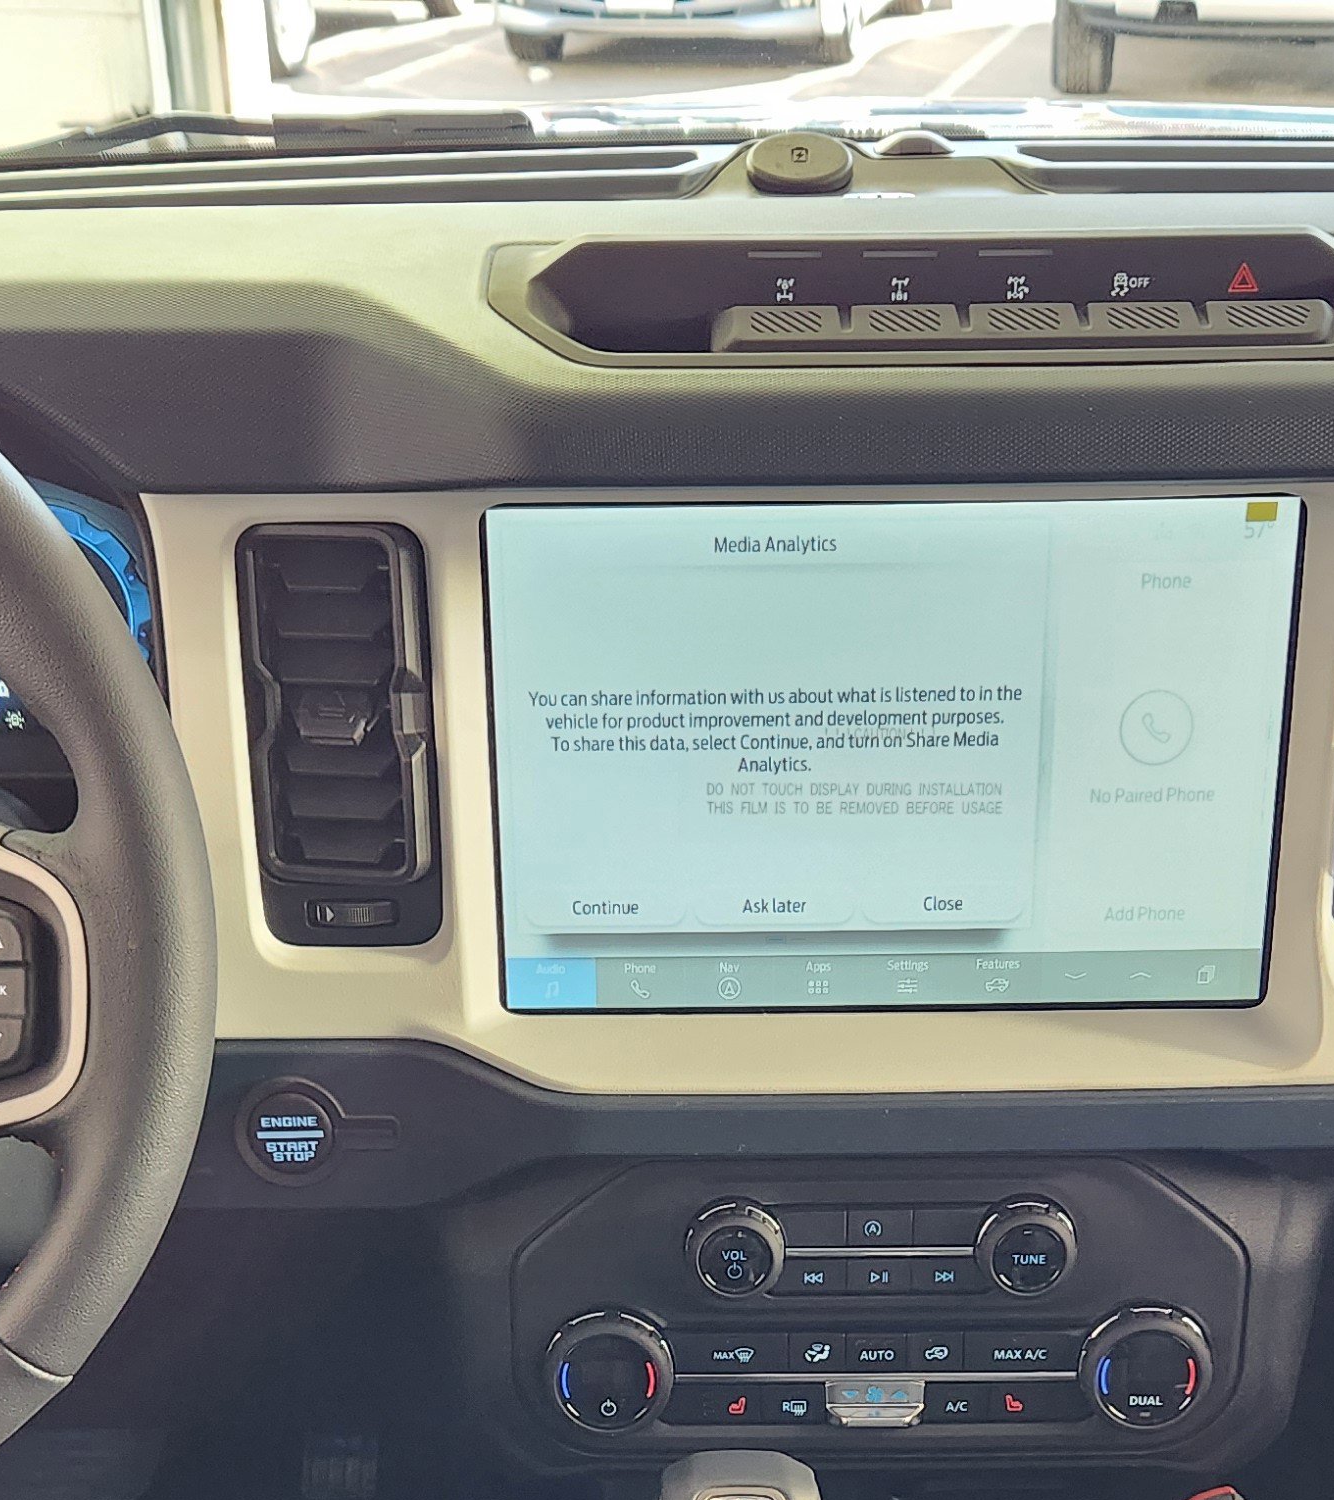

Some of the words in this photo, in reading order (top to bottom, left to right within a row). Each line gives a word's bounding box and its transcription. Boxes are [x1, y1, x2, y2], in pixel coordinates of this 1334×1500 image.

[1129, 276, 1151, 289] OFF
[714, 536, 760, 553] Media
[764, 535, 837, 555] Analytics
[1141, 572, 1193, 590] Phone
[528, 691, 557, 707] You
[560, 694, 587, 706] can
[591, 690, 633, 706] share
[636, 688, 727, 706] information
[730, 688, 764, 705] with
[768, 691, 785, 704] us
[789, 687, 832, 704] about
[837, 686, 876, 703] what
[880, 686, 892, 703] is
[896, 685, 956, 702] listened
[960, 688, 975, 701] to
[979, 686, 993, 701] in
[997, 685, 1022, 701] the
[546, 713, 598, 729] vehicle
[602, 713, 624, 729] for
[627, 713, 685, 731] product
[689, 712, 790, 731] improvement
[795, 711, 824, 727] and
[827, 710, 927, 729] development
[931, 711, 1005, 728] purposes.
[551, 736, 570, 752] To
[574, 736, 615, 752] share
[618, 735, 646, 751] this
[650, 735, 690, 752] data,
[692, 735, 736, 751] select
[740, 734, 813, 751] Continue,
[817, 733, 845, 749] and
[849, 733, 880, 749] turn
[883, 736, 903, 748] on
[906, 731, 950, 748] Share
[954, 731, 999, 747] Media
[738, 756, 812, 775] Analytics.
[706, 783, 724, 797] DO
[731, 783, 755, 797] NOT
[762, 783, 803, 797] TOUCH
[810, 783, 859, 797] DISPLAY
[867, 783, 912, 797] DURING
[918, 782, 1002, 796] INSTALLATION
[1089, 788, 1111, 803] No
[1115, 788, 1163, 803] Paired
[1166, 787, 1216, 802] Phone
[708, 801, 734, 815] THIS
[741, 801, 768, 815] FILM
[775, 801, 786, 815] IS
[793, 801, 809, 815] TO
[817, 801, 833, 815] BE
[839, 801, 900, 815] REMOVED
[906, 801, 955, 815] BEFORE
[961, 801, 1003, 815] USAGE
[572, 900, 639, 916] Continue
[742, 898, 768, 914] Ask
[772, 898, 806, 914] later
[923, 896, 963, 911] Close
[1104, 907, 1134, 921] Add
[1137, 906, 1185, 921] Phone
[536, 963, 565, 975] Audio
[624, 962, 657, 974] Phone
[719, 962, 740, 973] Nav
[805, 961, 831, 974] Apps
[887, 959, 929, 972] Settings
[976, 958, 1020, 970] Features
[260, 1116, 318, 1128] ENGINE
[265, 1141, 319, 1153] START
[272, 1151, 315, 1162] STOP
[721, 1250, 748, 1262] VOL
[1012, 1254, 1046, 1266] TUNE
[713, 1350, 735, 1361] MAX
[859, 1349, 895, 1362] AUTO
[994, 1349, 1022, 1361] MAX
[1024, 1348, 1048, 1361] A/C
[945, 1401, 967, 1413] A/C
[1128, 1395, 1163, 1407] DUAL
